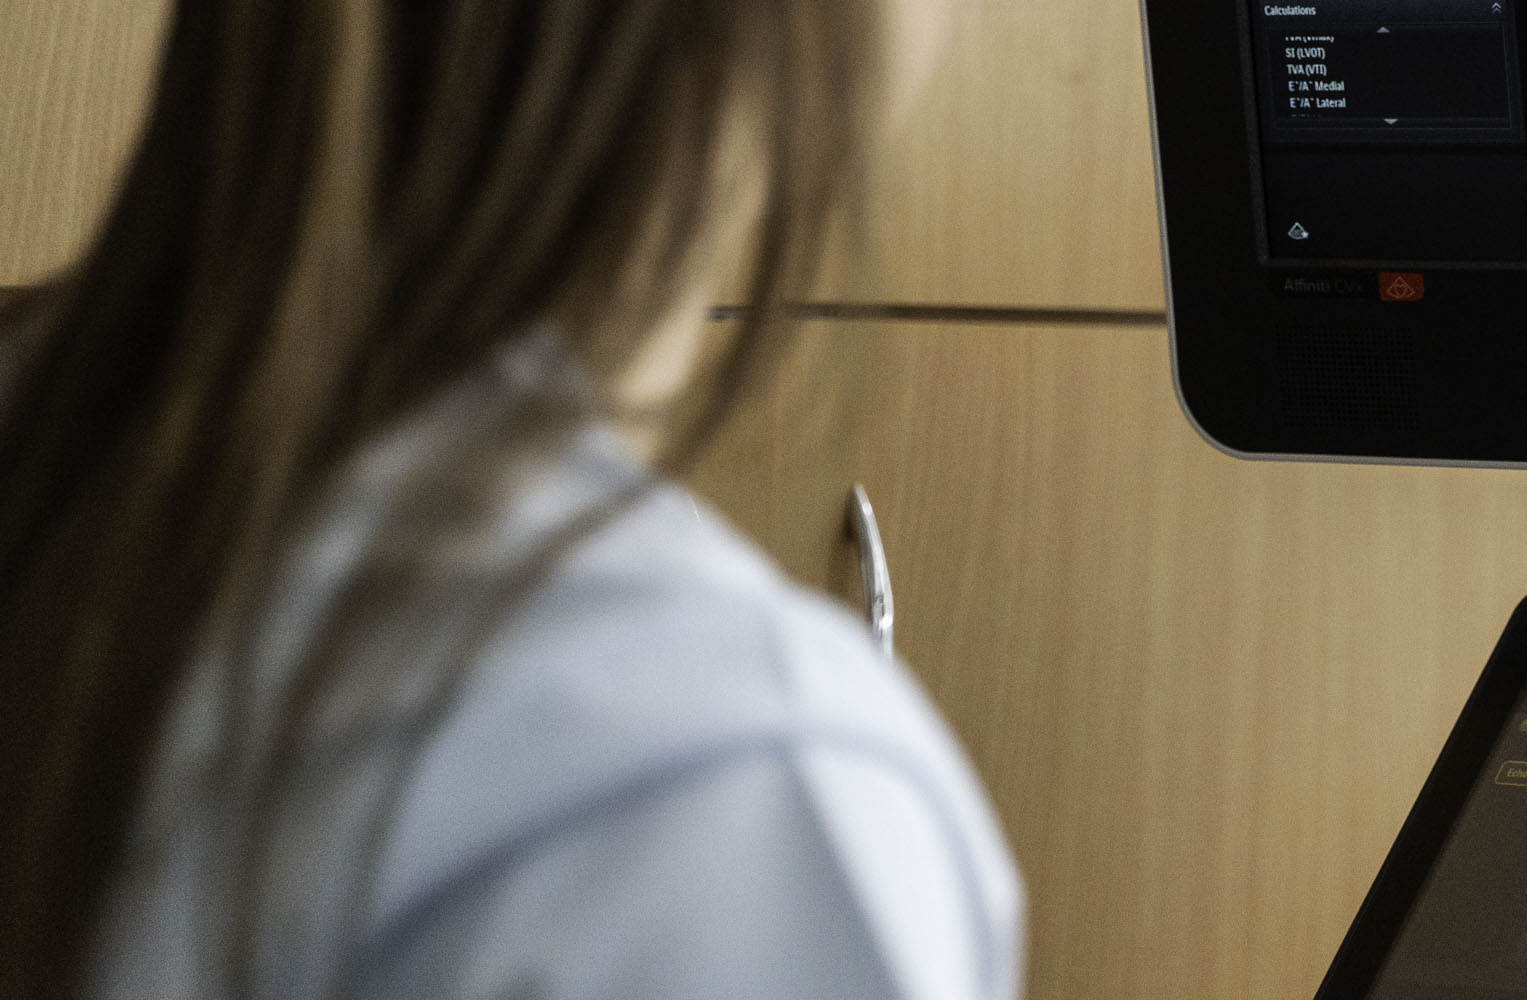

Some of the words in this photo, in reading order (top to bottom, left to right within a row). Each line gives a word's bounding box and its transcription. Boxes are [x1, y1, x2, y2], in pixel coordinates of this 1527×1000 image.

[1264, 5, 1316, 16] Calculations
[1296, 47, 1326, 60] (LVOT)
[1314, 80, 1344, 92] Medial
[1316, 98, 1346, 108] Lateral
